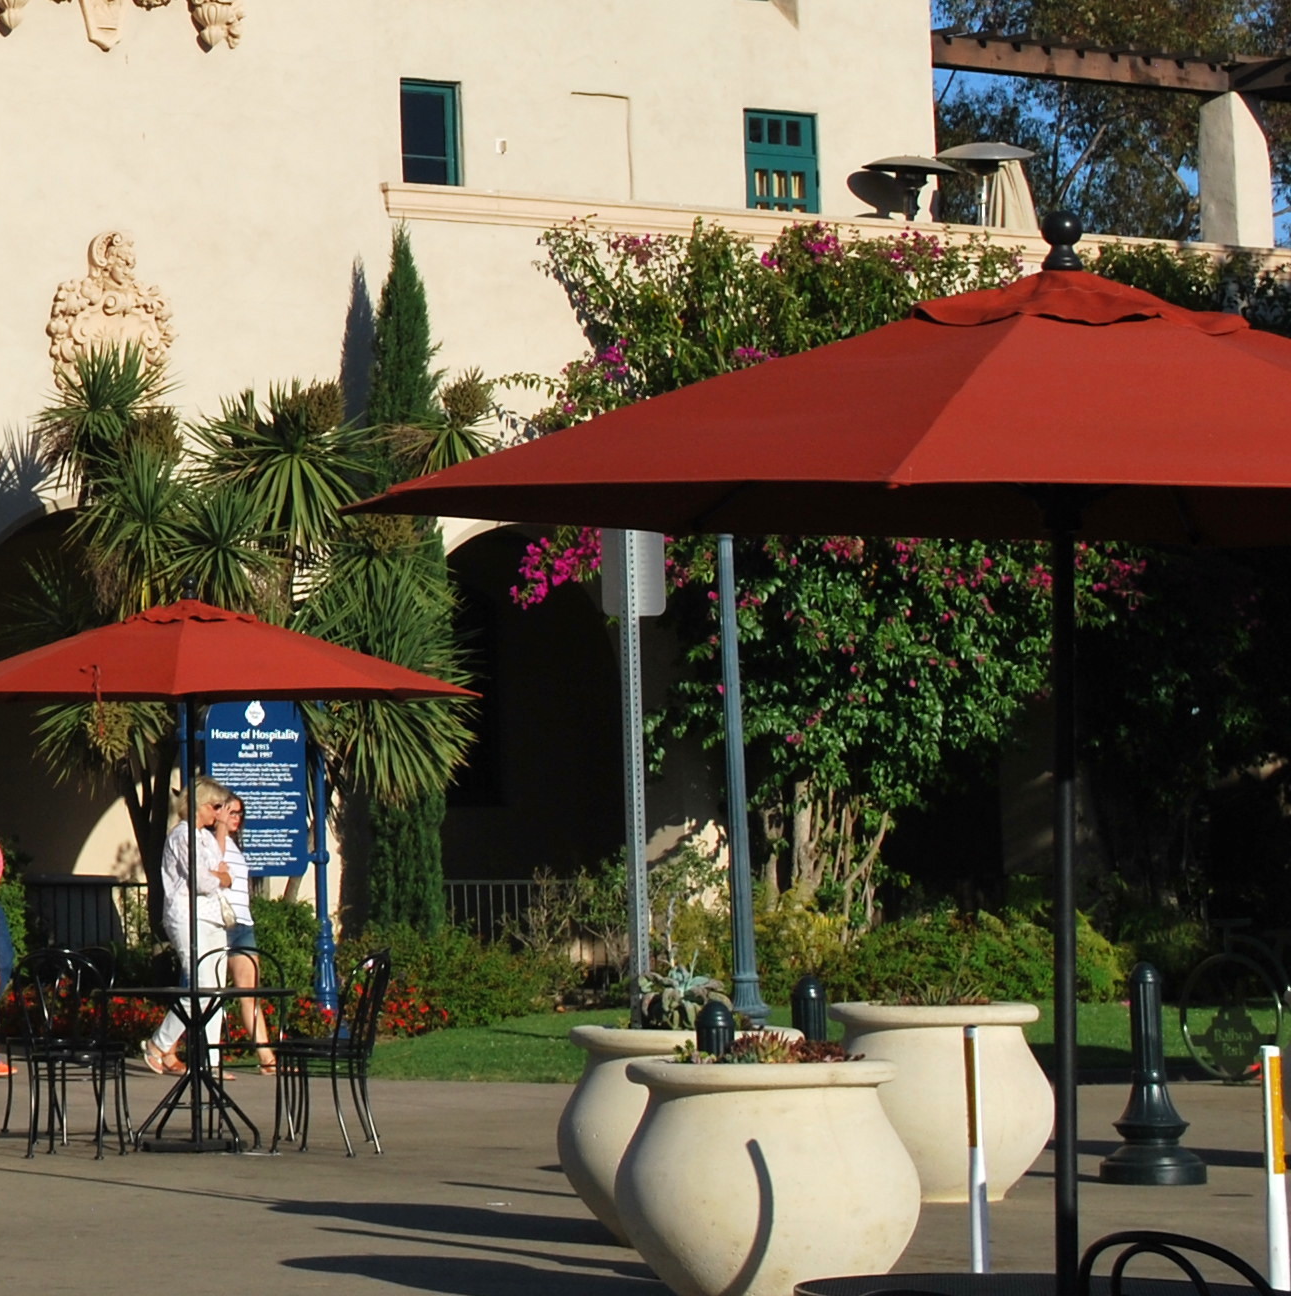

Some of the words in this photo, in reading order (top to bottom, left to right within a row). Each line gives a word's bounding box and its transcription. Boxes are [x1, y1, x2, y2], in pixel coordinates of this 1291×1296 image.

[211, 729, 239, 740] House
[241, 729, 251, 740] of
[252, 729, 299, 743] Hospitality
[1214, 1027, 1253, 1042] Balboa
[1222, 1043, 1245, 1056] Park
